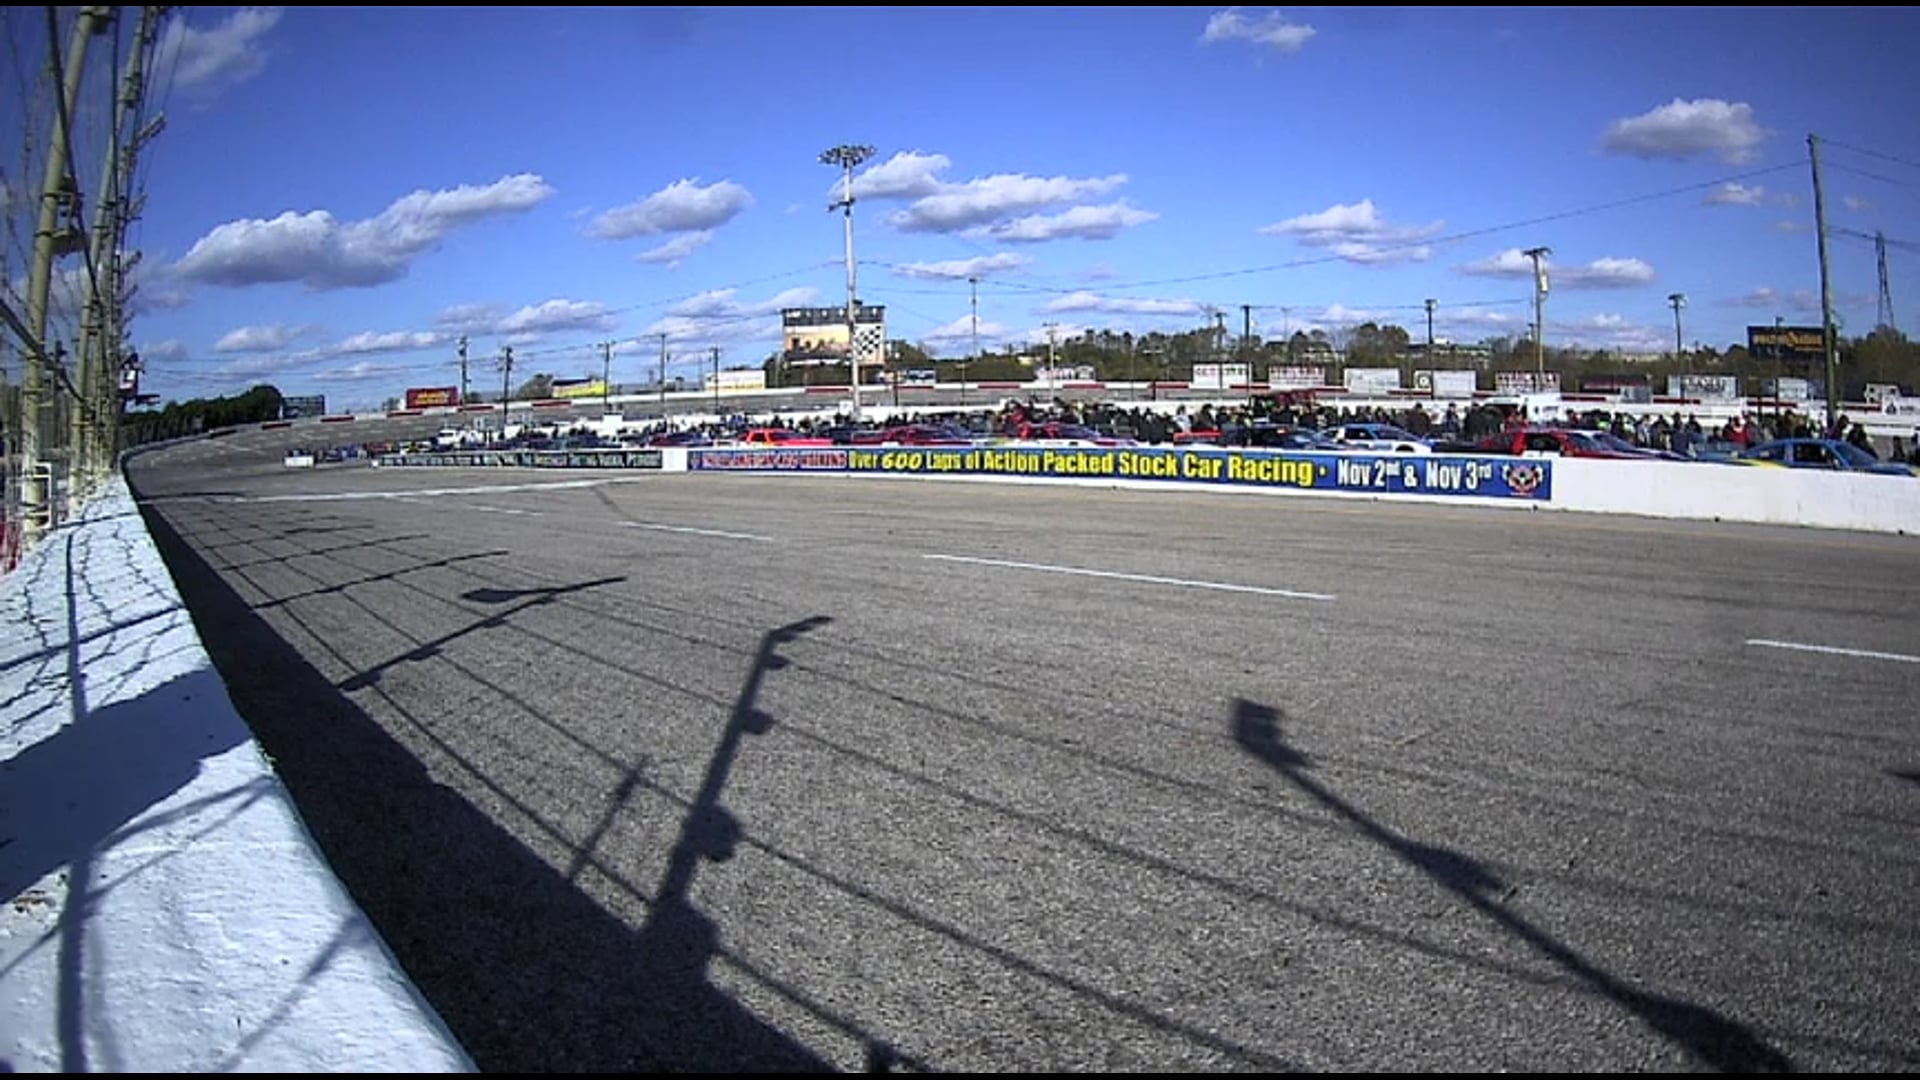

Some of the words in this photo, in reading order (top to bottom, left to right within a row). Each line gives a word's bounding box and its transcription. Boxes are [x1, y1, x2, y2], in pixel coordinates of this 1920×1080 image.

[881, 452, 922, 470] 600
[926, 451, 961, 471] Laps
[965, 452, 980, 469] of
[983, 451, 1038, 472] Action
[1043, 451, 1114, 474] Packed
[1118, 451, 1178, 476] Stock
[1183, 452, 1223, 478] Car
[1228, 454, 1314, 487] Racing
[1337, 458, 1371, 485] Nov
[1374, 459, 1400, 487] 2nd
[1403, 465, 1418, 488] &
[1426, 460, 1461, 489] Nov
[1466, 461, 1493, 490] 3rd
